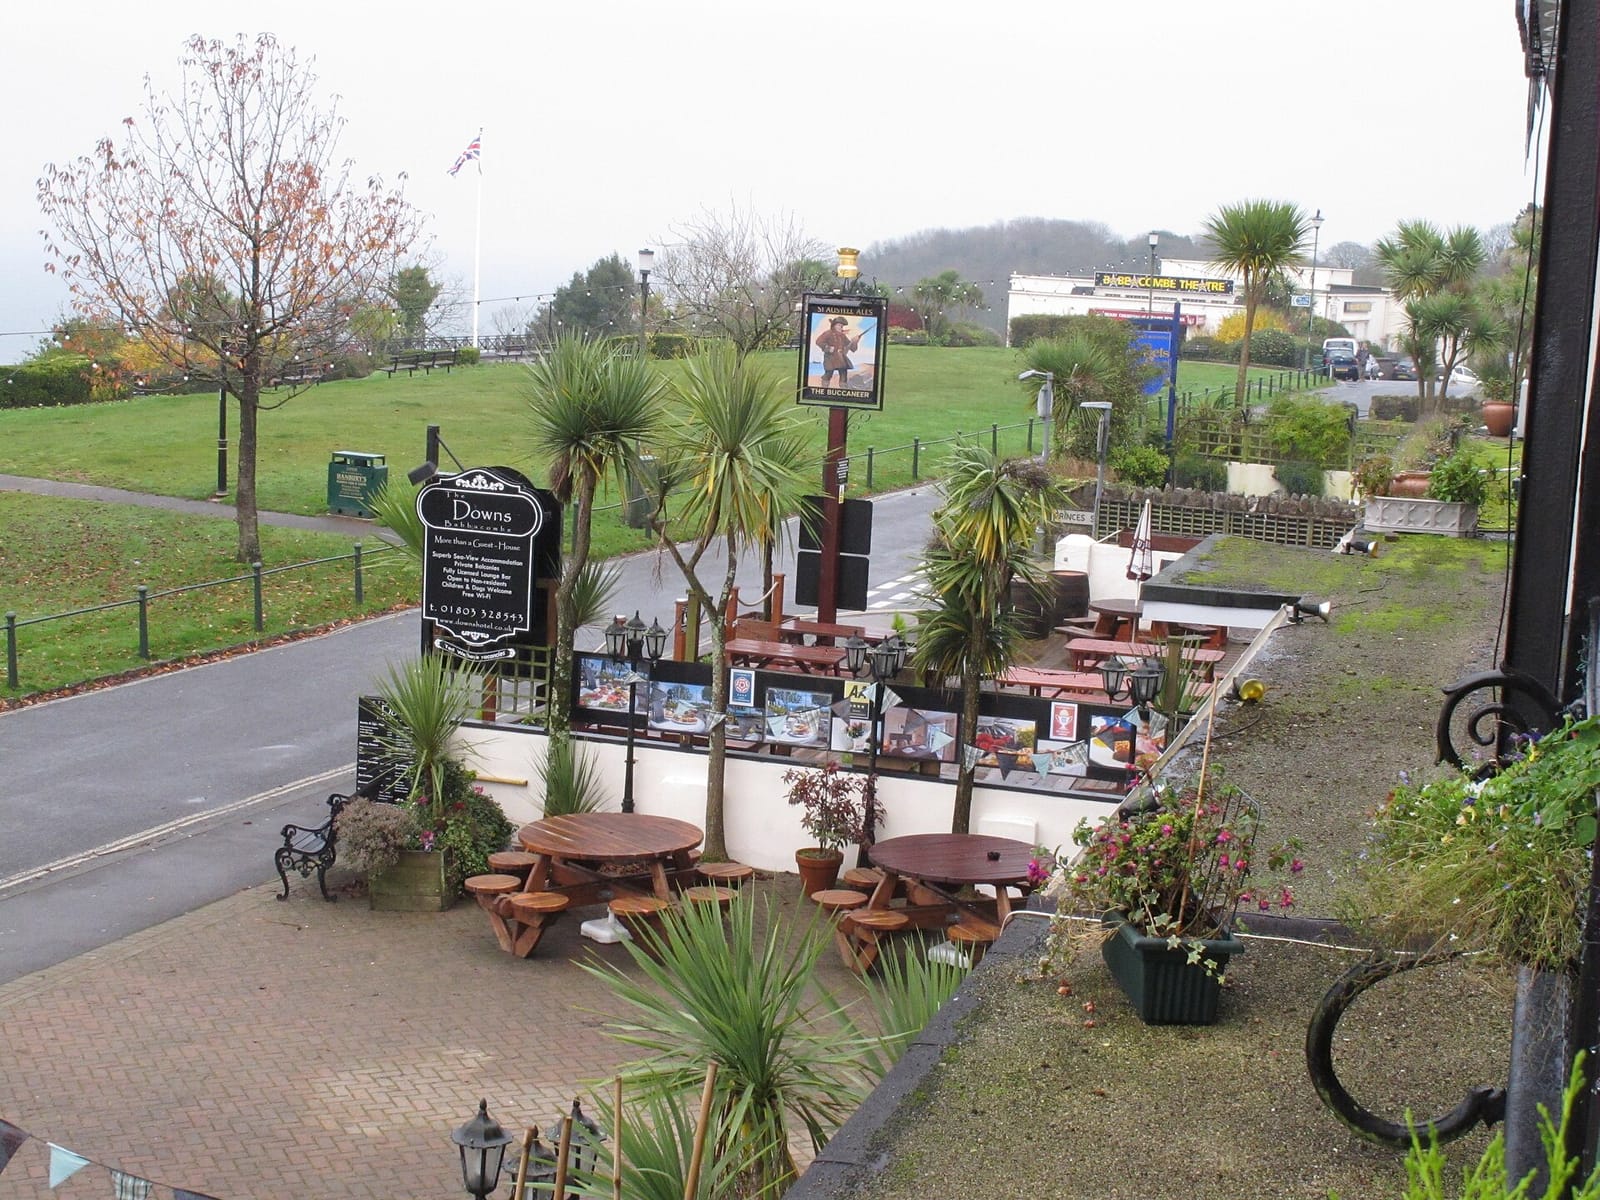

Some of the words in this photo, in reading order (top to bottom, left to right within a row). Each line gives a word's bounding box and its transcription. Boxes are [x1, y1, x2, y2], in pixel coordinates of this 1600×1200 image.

[1179, 279, 1225, 292] THEATRE
[826, 389, 869, 399] BUCCANEER
[446, 491, 465, 499] The
[453, 499, 512, 523] Downs
[444, 519, 512, 533] Babbacombe
[434, 535, 452, 544] More
[453, 537, 467, 546] than
[473, 539, 493, 548] Guest
[498, 541, 521, 551] House
[432, 550, 452, 559] Superb
[453, 552, 479, 561] Sea-View
[481, 556, 523, 566] Accommodation
[442, 566, 455, 575] Fully
[457, 568, 480, 577] Licensed
[480, 571, 500, 579] Lounge
[475, 563, 500, 571] Balconies
[446, 574, 462, 582] Open
[441, 580, 464, 589] Children
[471, 584, 485, 592] Dogs
[487, 586, 513, 595] Welcome
[462, 590, 475, 598] Free
[440, 604, 477, 618] 01803
[481, 609, 524, 624] 328543
[440, 618, 512, 632] www.downshotel.co.uk
